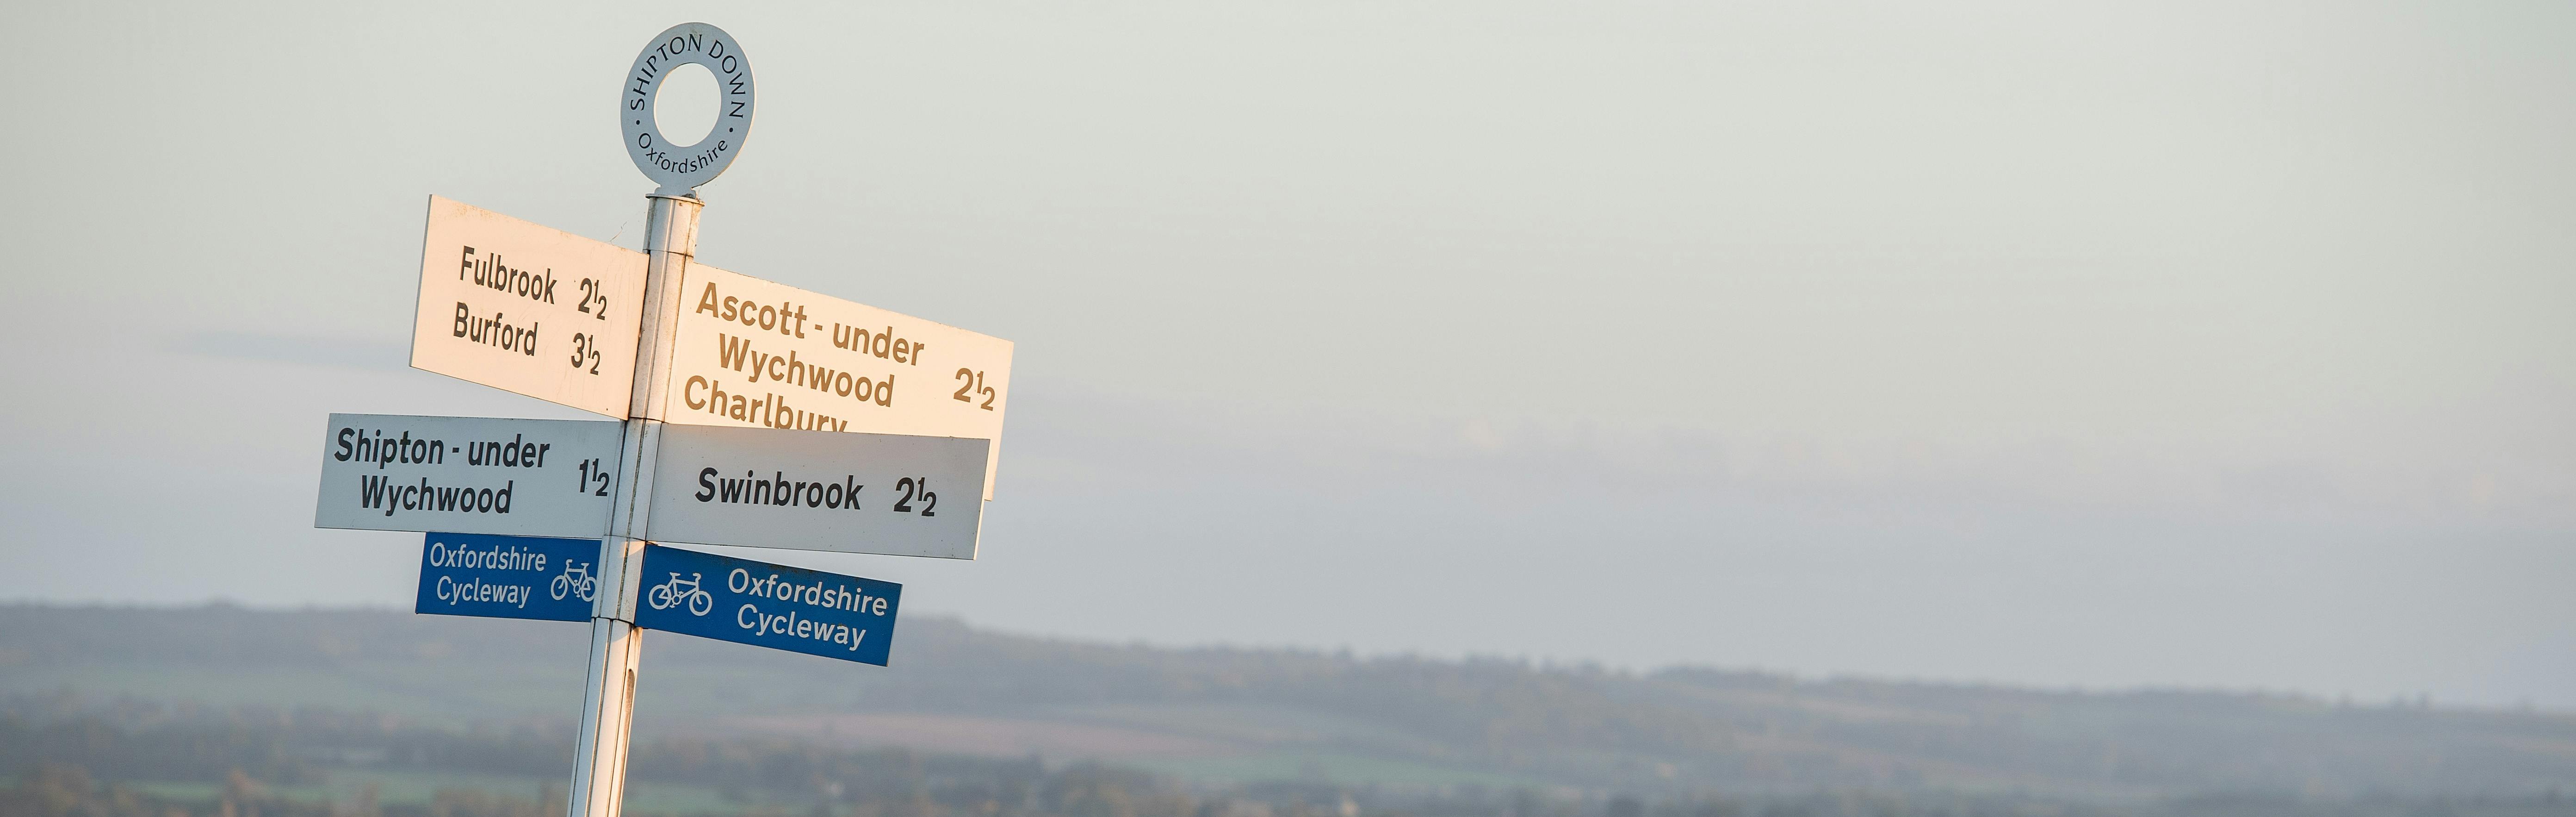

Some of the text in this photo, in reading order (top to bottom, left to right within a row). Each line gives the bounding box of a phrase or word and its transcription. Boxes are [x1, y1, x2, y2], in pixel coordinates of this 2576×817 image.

[630, 34, 746, 118] SHIPTON DOWN
[638, 132, 728, 173] Oxfordshire
[460, 245, 557, 305] Fulbrook
[453, 302, 538, 356] Burford
[696, 282, 807, 339] Ascott
[833, 323, 924, 366] under
[719, 333, 895, 407] Wychwood
[334, 427, 444, 469] Shipton
[468, 434, 550, 468] under
[361, 475, 514, 517] Wychwood
[695, 467, 864, 510] Swinbrook
[430, 543, 546, 572] Oxfordshire
[437, 575, 531, 609] Cycleway
[728, 568, 888, 617] Oxfordshire
[737, 604, 866, 651] Cycleway
